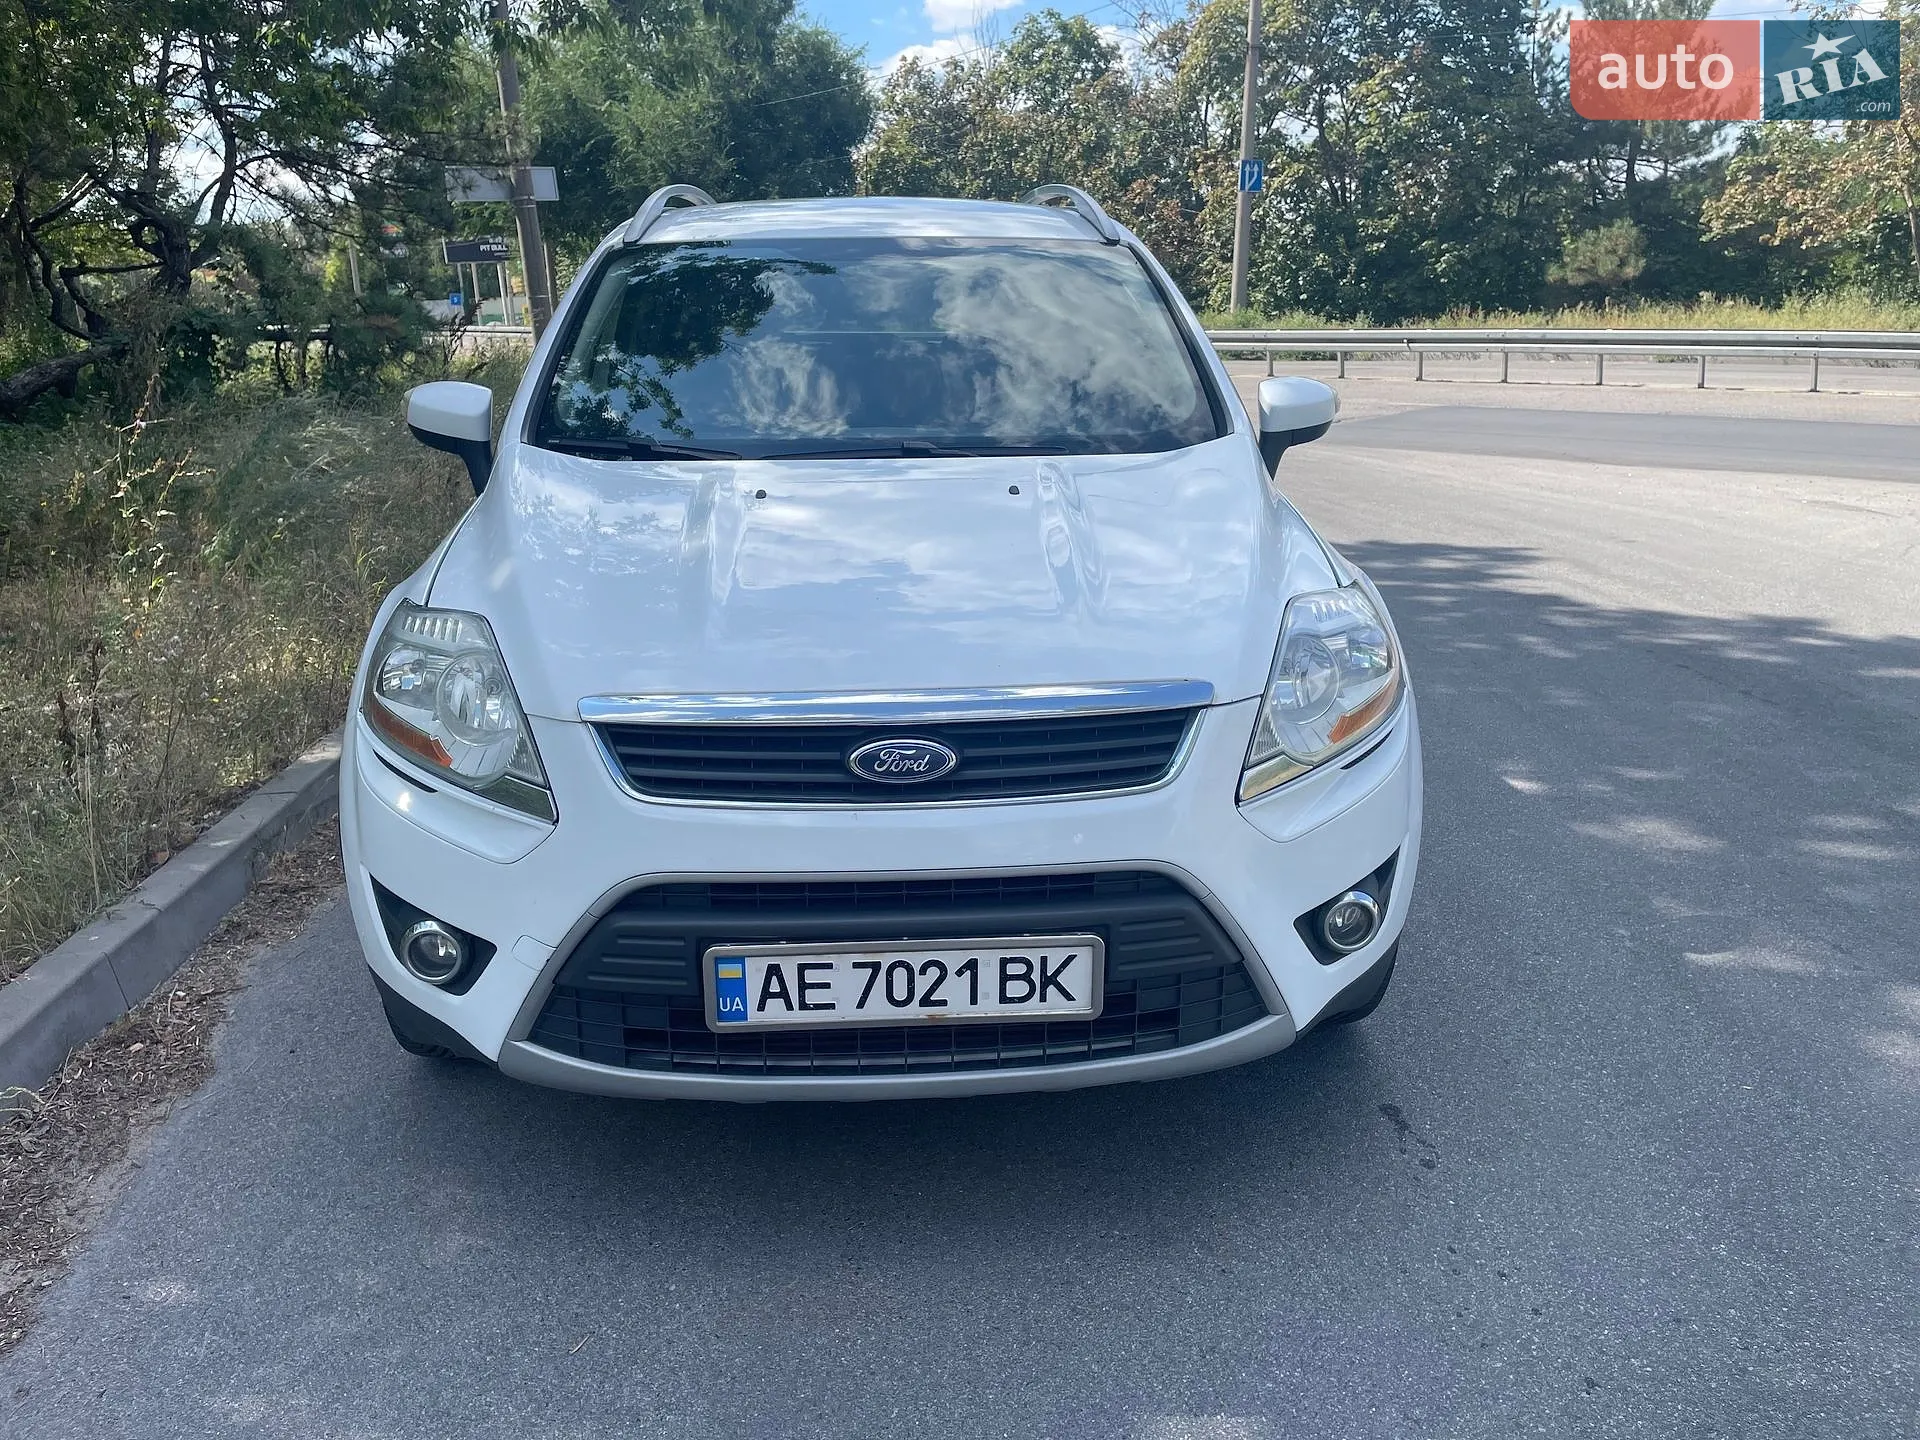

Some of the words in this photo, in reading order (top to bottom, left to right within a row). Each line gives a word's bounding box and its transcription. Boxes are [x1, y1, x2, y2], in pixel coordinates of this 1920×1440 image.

[874, 748, 931, 772] Ford
[756, 962, 837, 1012] AE
[851, 956, 979, 1010] 7021
[998, 953, 1078, 1005] BK
[719, 997, 744, 1012] UA
